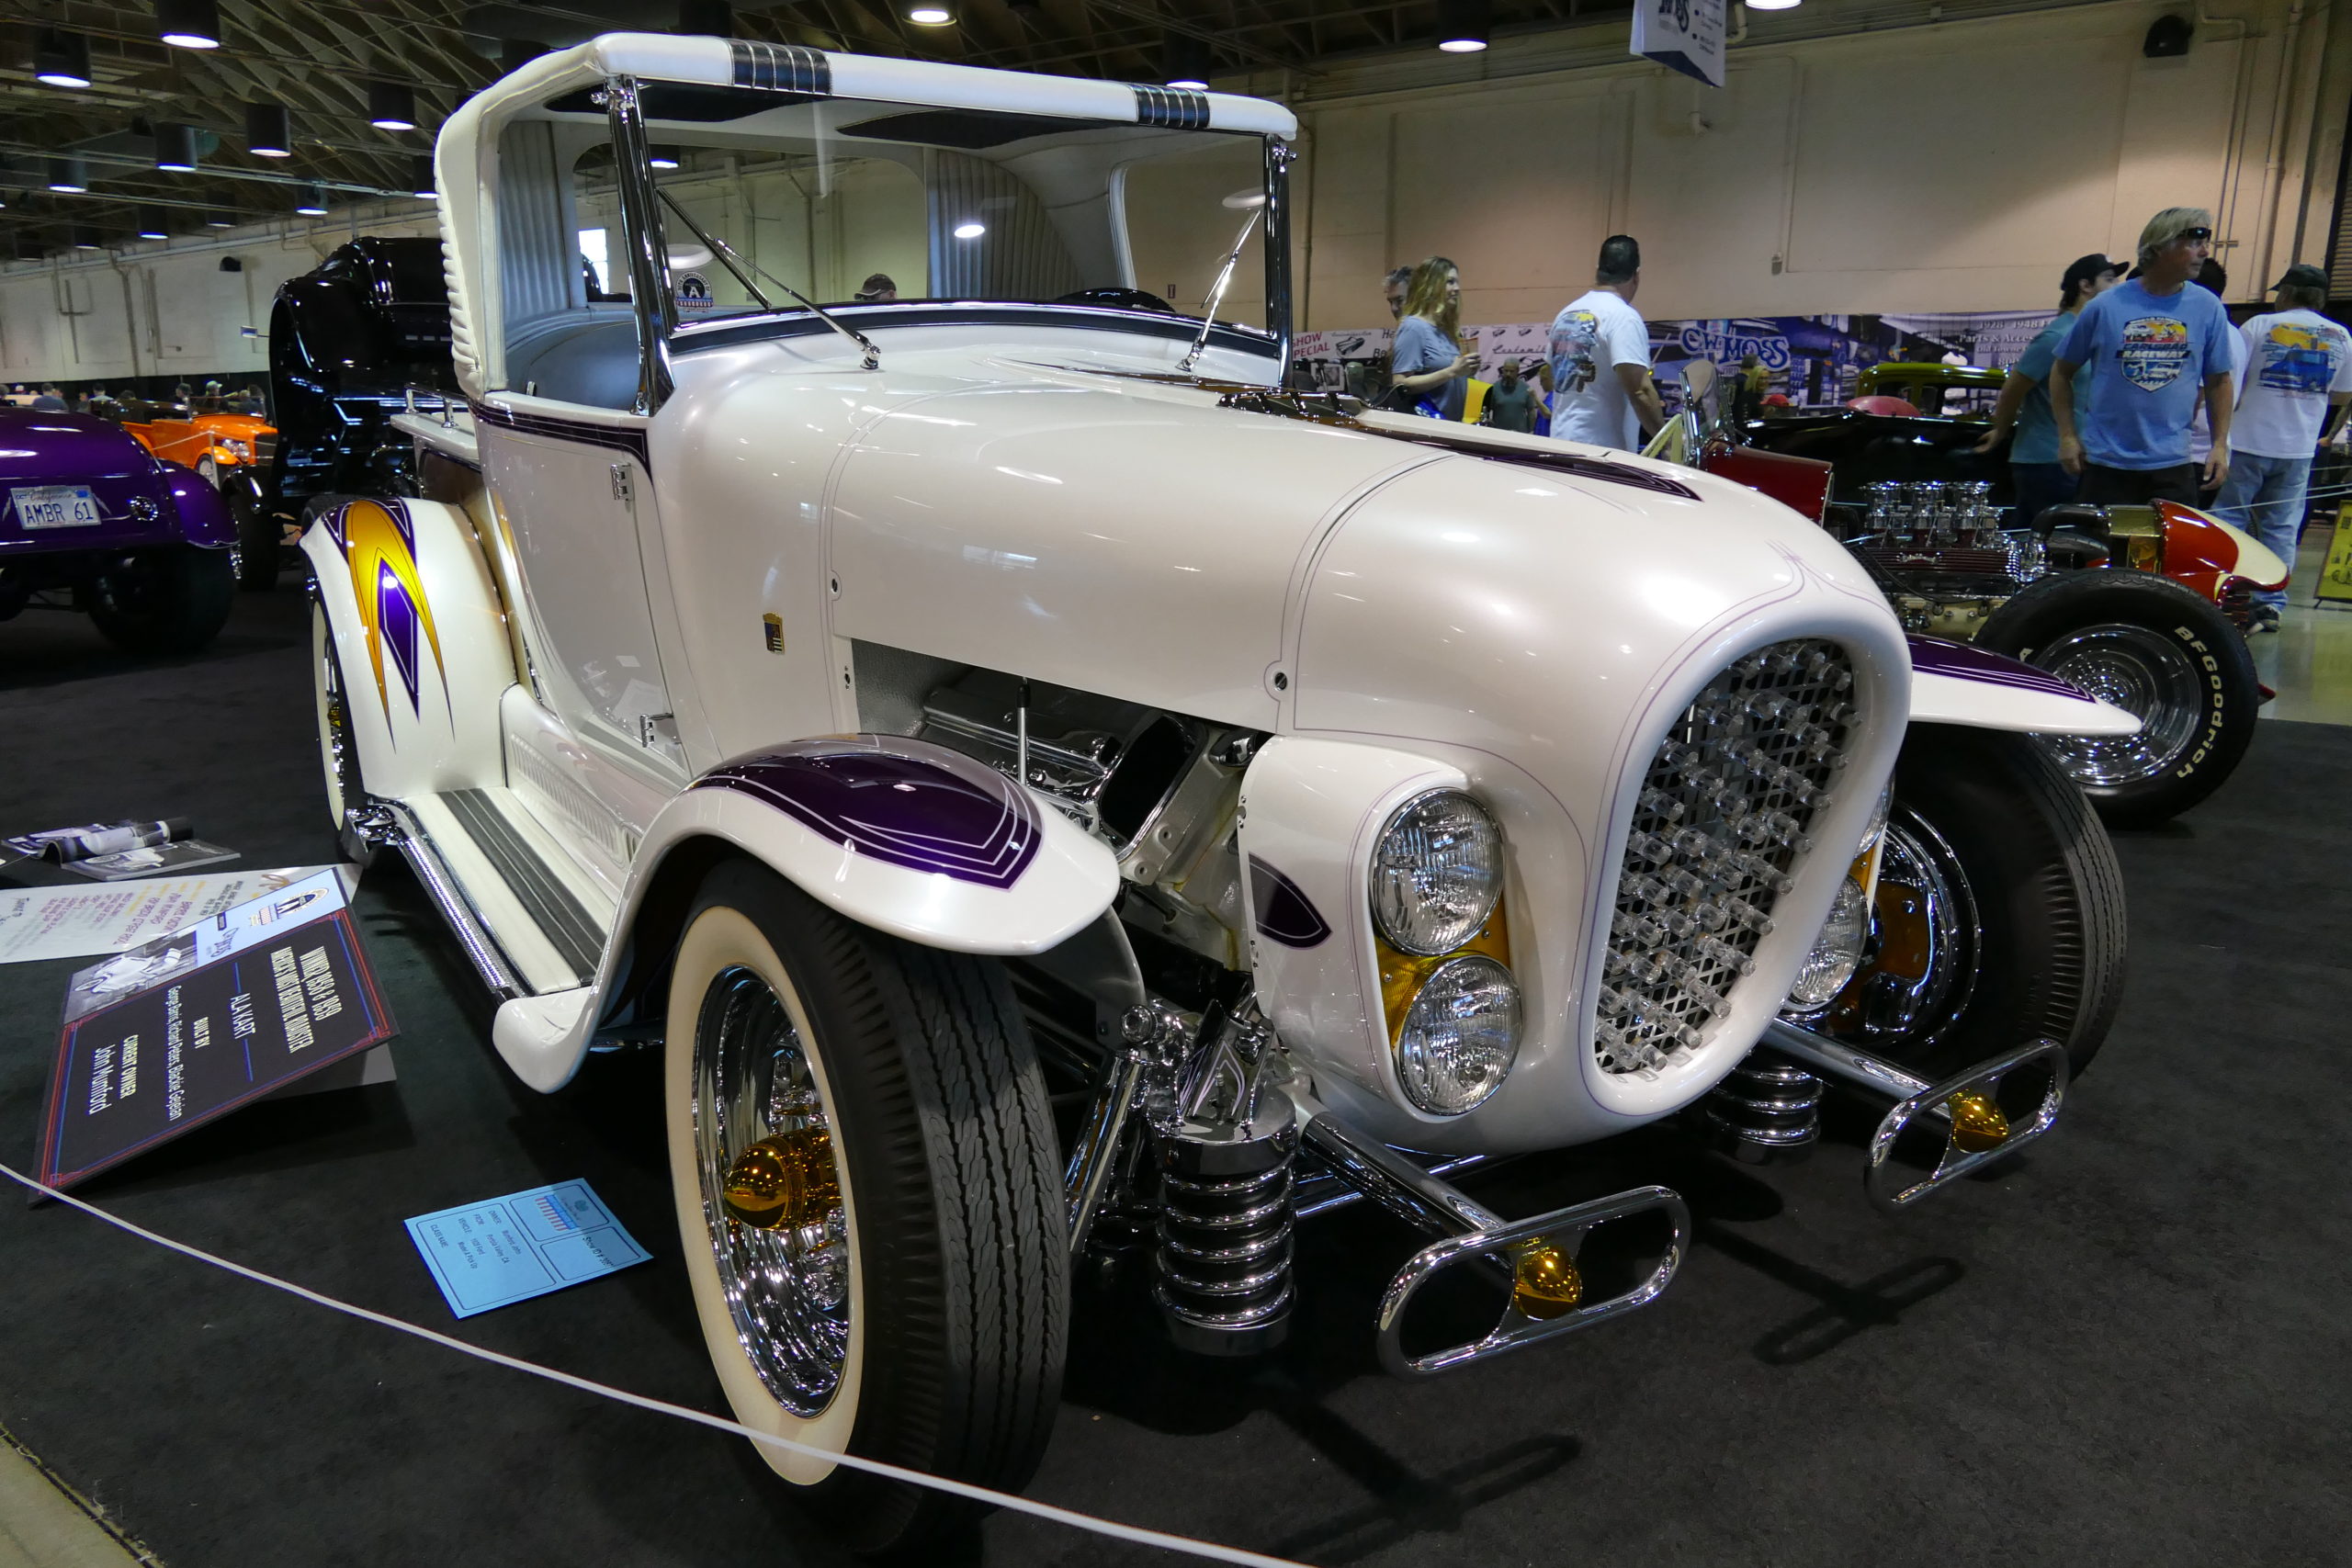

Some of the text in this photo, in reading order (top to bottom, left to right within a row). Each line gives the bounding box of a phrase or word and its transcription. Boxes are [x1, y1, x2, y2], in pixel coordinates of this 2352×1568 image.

[689, 287, 701, 299] A
[1294, 342, 1330, 358] PECIAL
[1959, 333, 1990, 344] Parts
[1992, 334, 2001, 344] &
[1719, 336, 1790, 370] MOSS
[2122, 350, 2187, 358] RACEWAY
[24, 502, 94, 524] AMBR 61
[2174, 626, 2224, 779] BFGoodrich
[300, 946, 330, 982] WINNER
[306, 972, 334, 995] 1958
[312, 989, 334, 1000] &
[165, 986, 181, 1007] George
[271, 947, 313, 1053] AMERICA'S MOST BEAUTIFUL ROADSTER
[312, 996, 342, 1021] 1959
[231, 993, 255, 1039] ALA KART
[168, 1021, 183, 1045] Richard
[194, 1017, 209, 1048] BUILT BY
[120, 1035, 138, 1099] CURRENT OWNER
[167, 1043, 183, 1068] Peters,
[89, 1044, 116, 1114] John Mumford
[168, 1064, 184, 1092] Blackie
[166, 1090, 185, 1121] Gejeian
[431, 1224, 444, 1237] CLASS
